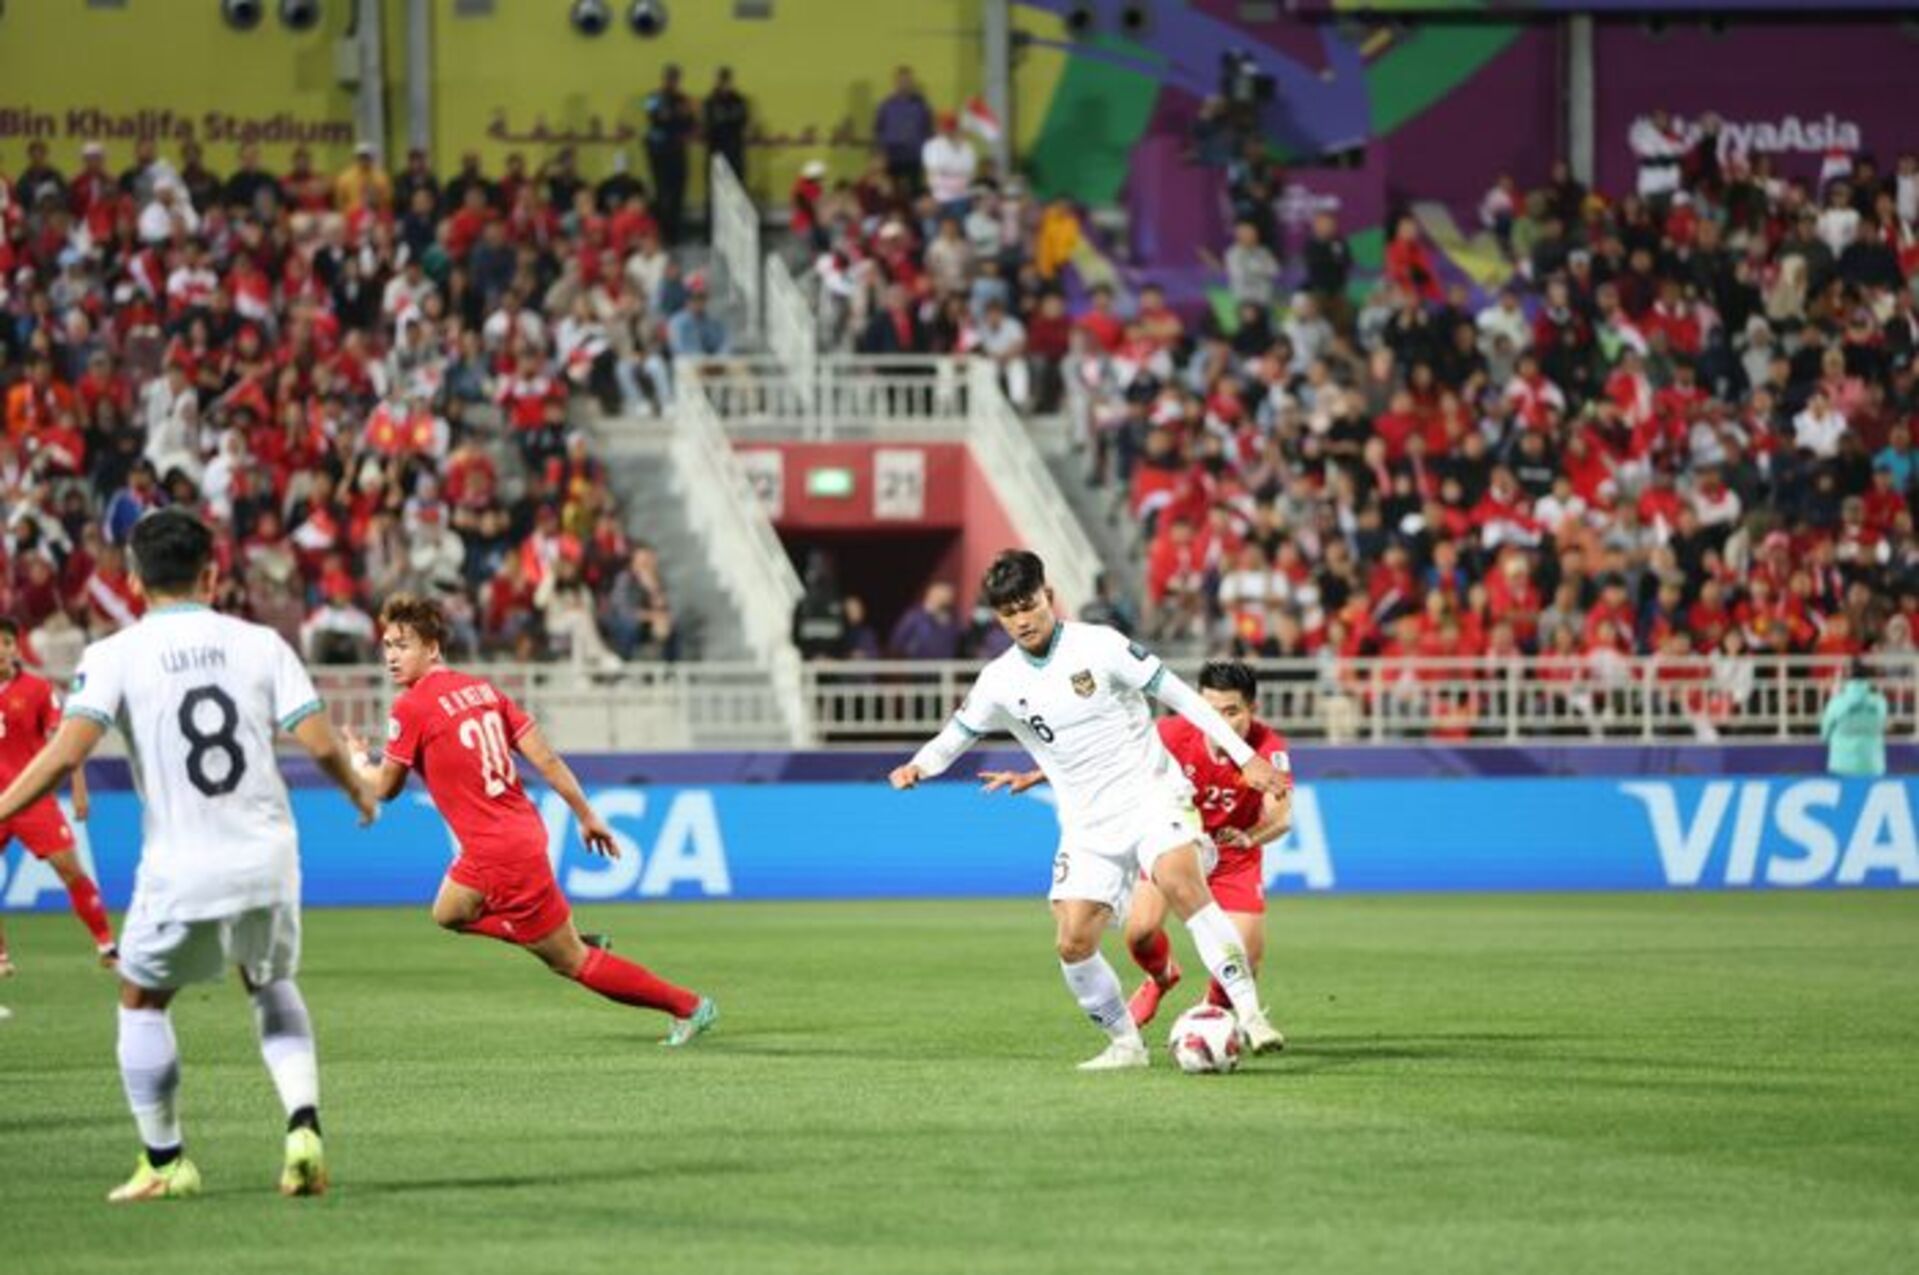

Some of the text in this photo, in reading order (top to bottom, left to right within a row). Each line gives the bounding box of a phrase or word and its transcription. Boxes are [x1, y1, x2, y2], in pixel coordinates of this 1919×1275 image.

[0, 110, 353, 144] Bin Khalifa Stadium
[178, 684, 247, 797] 8
[459, 711, 516, 797] 20
[1202, 785, 1238, 813] 25
[1619, 778, 1919, 884] VISA
